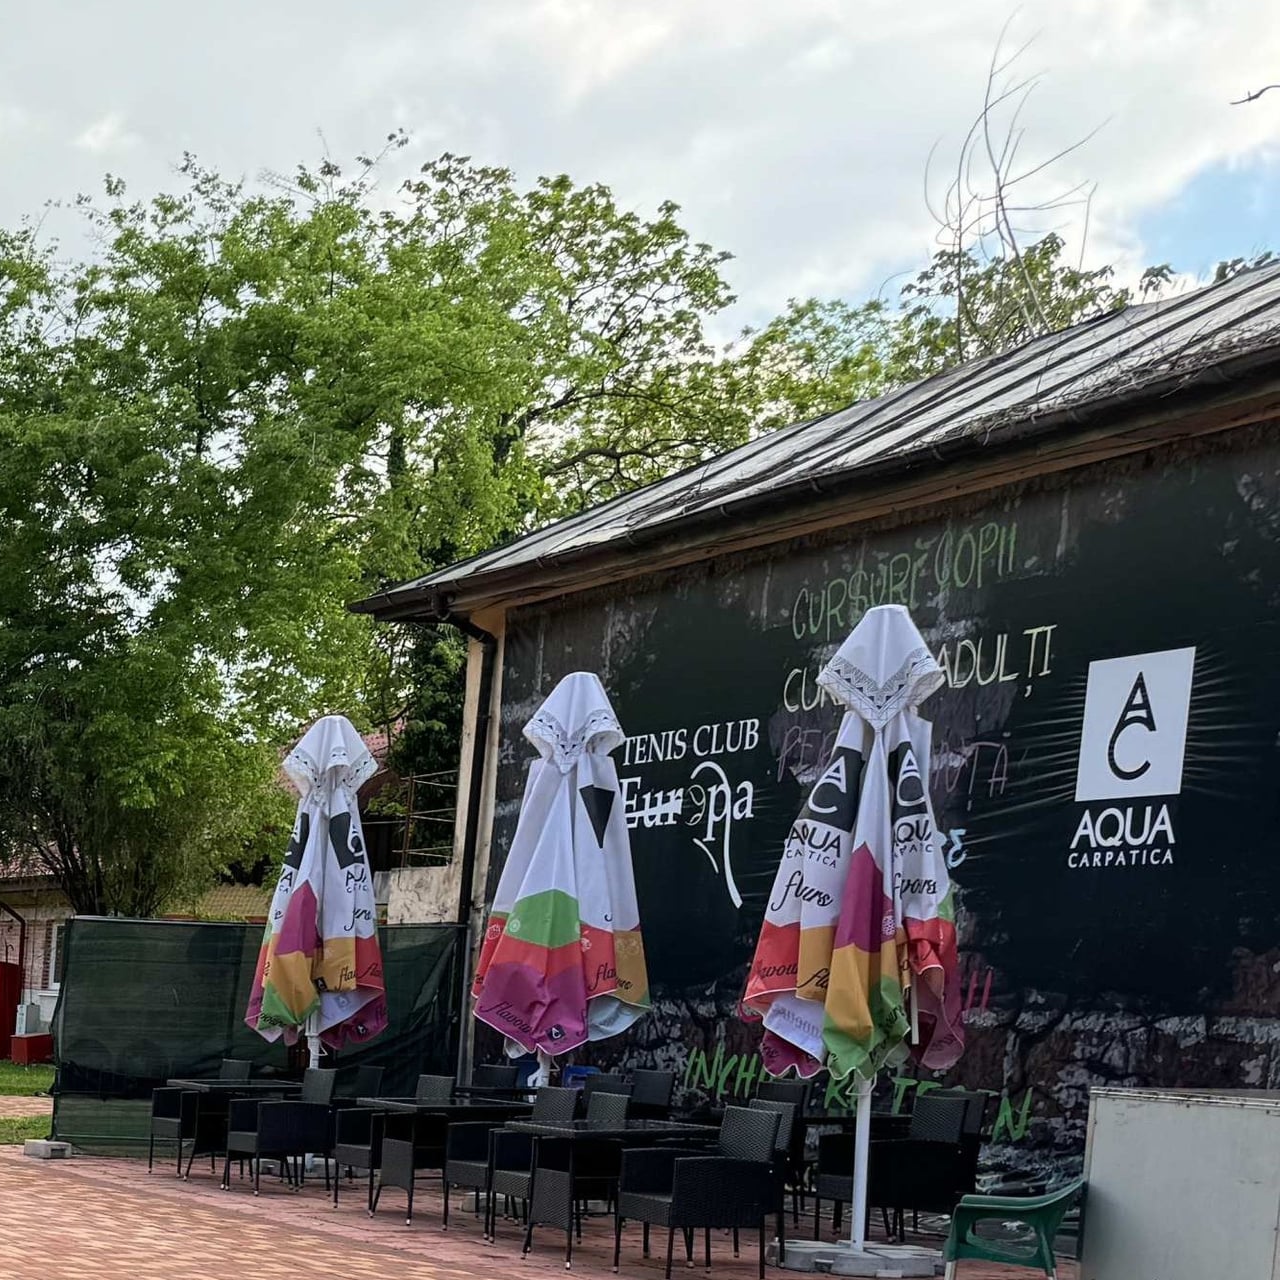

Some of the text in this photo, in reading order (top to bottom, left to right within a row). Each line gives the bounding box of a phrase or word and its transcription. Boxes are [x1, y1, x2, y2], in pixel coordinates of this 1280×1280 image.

[621, 728, 687, 767] TENIS
[692, 718, 760, 757] CLUB
[1069, 804, 1176, 849] AQUA
[1067, 848, 1174, 869] CARPATICA
